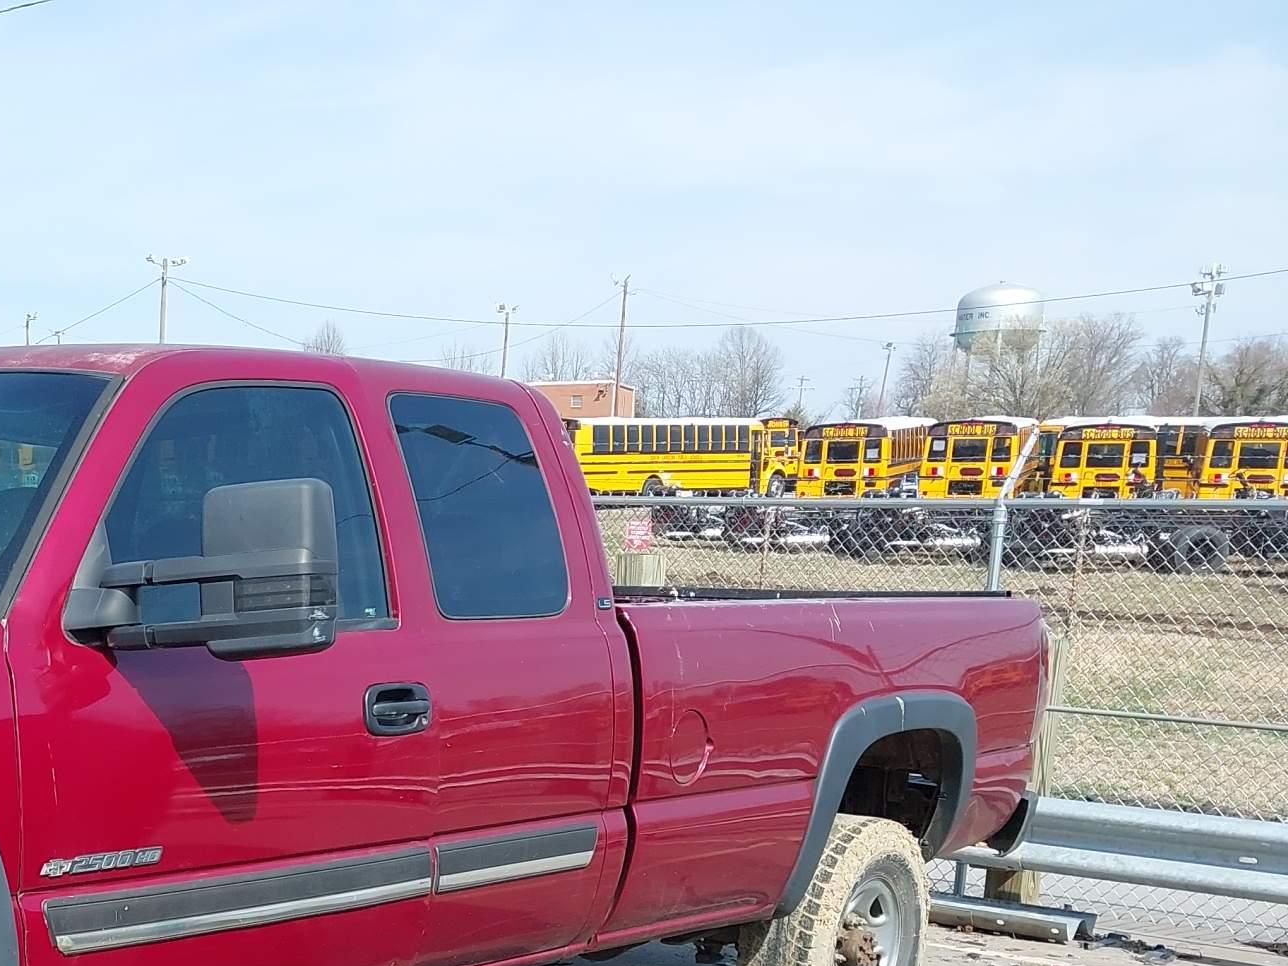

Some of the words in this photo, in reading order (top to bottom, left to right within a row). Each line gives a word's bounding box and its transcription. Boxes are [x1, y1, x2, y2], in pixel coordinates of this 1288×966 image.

[855, 426, 868, 436] BUS
[981, 424, 996, 434] BUS
[598, 599, 612, 609] LS
[70, 849, 135, 873] 2500
[135, 848, 162, 864] HD
